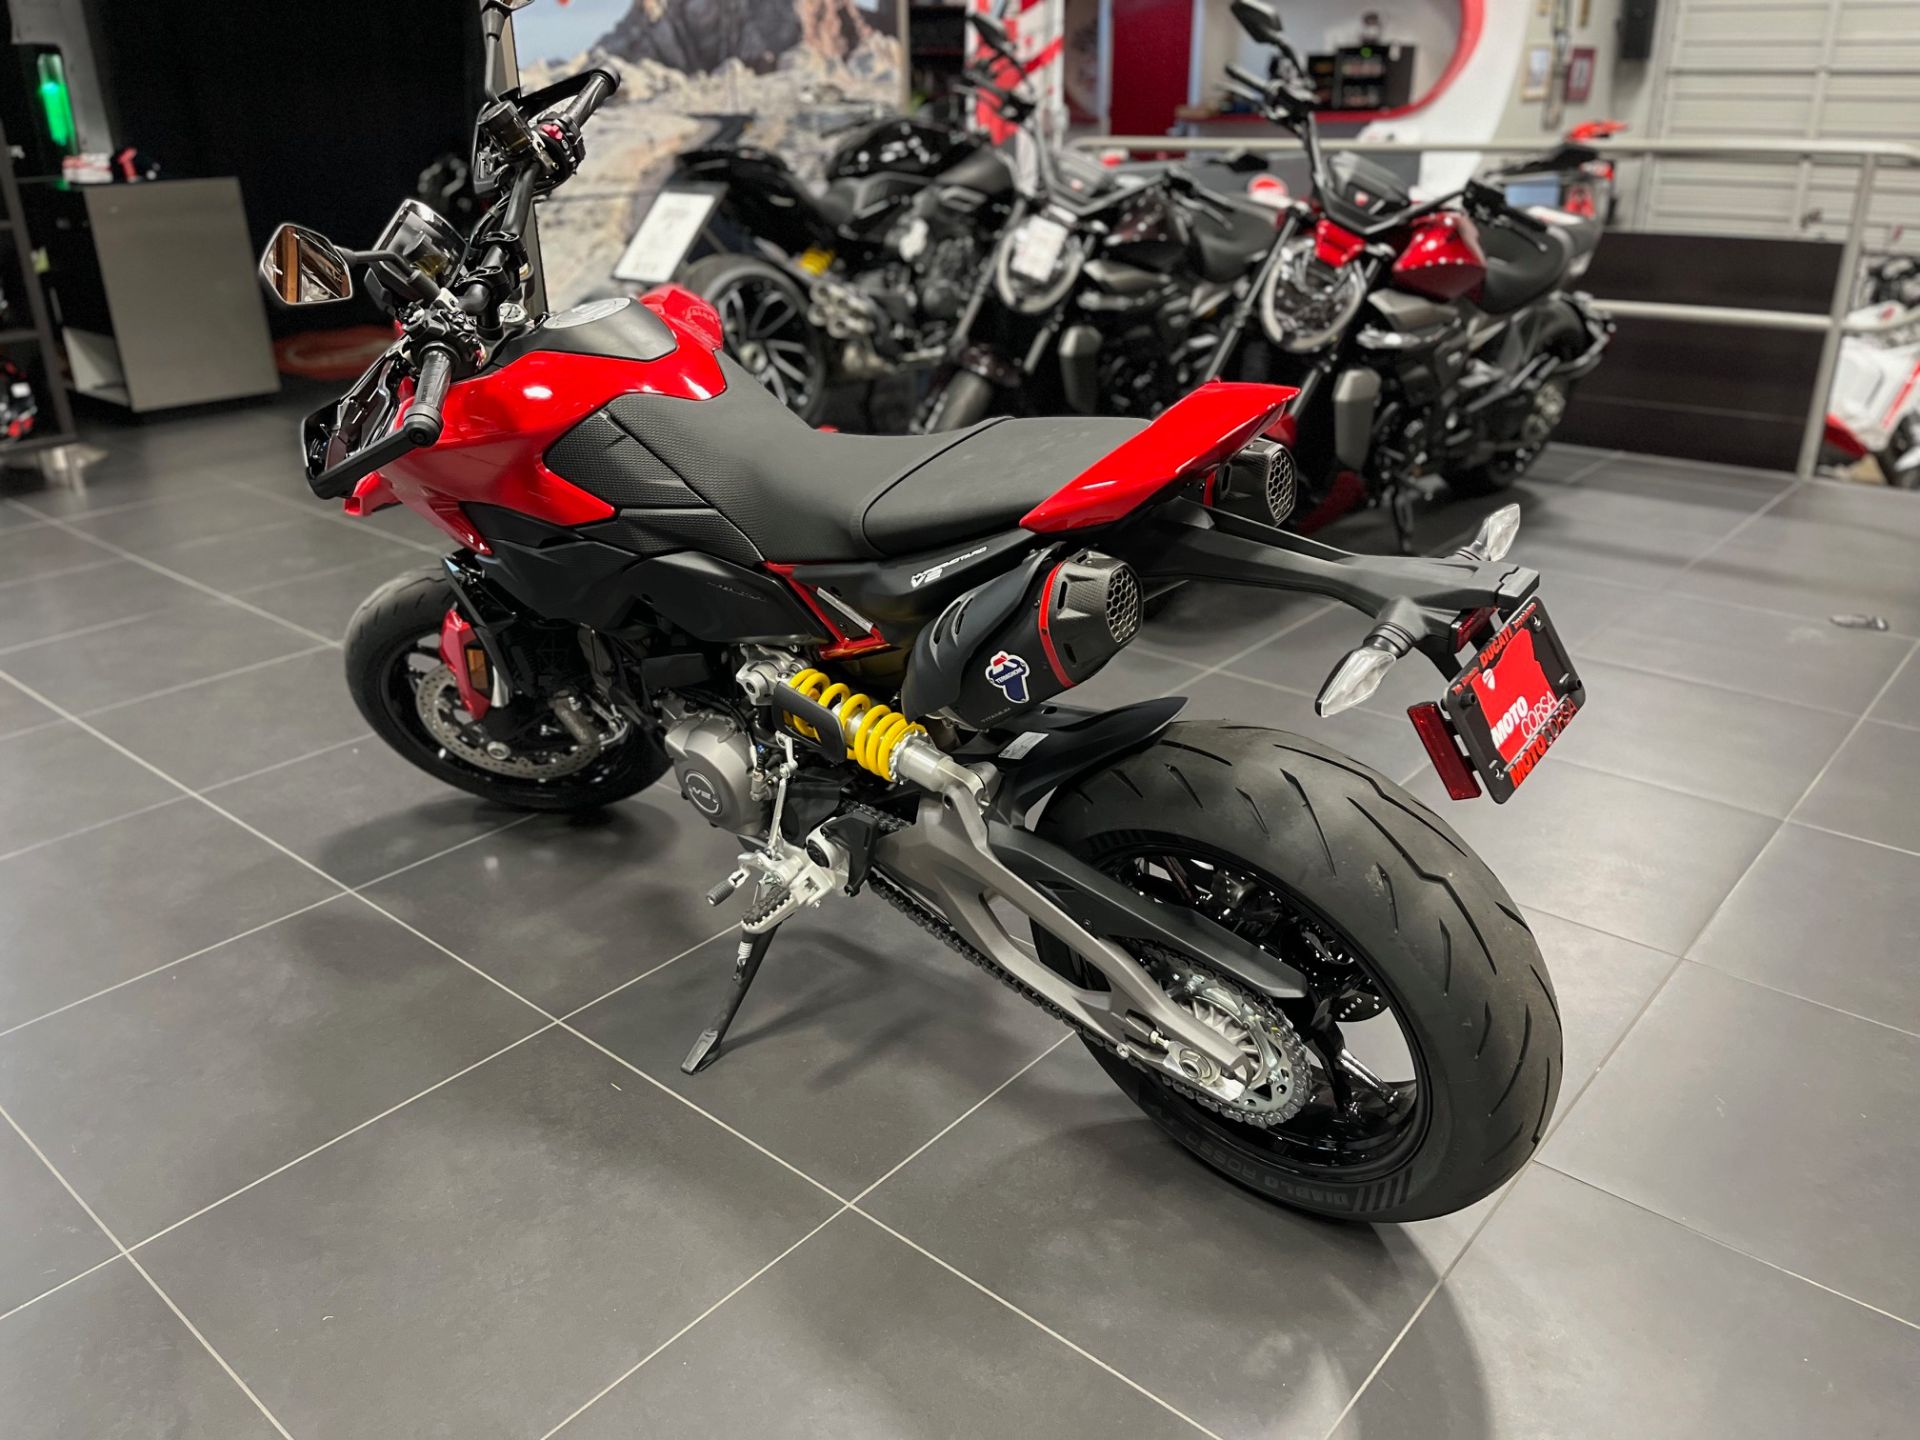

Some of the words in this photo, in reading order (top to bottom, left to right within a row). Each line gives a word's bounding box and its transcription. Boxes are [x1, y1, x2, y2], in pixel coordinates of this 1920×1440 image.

[1479, 624, 1513, 668] DUCATI
[1490, 696, 1528, 750] MOTO
[1521, 690, 1558, 739] CORSA
[1508, 733, 1548, 790] MOTO
[1541, 696, 1578, 746] CORSA
